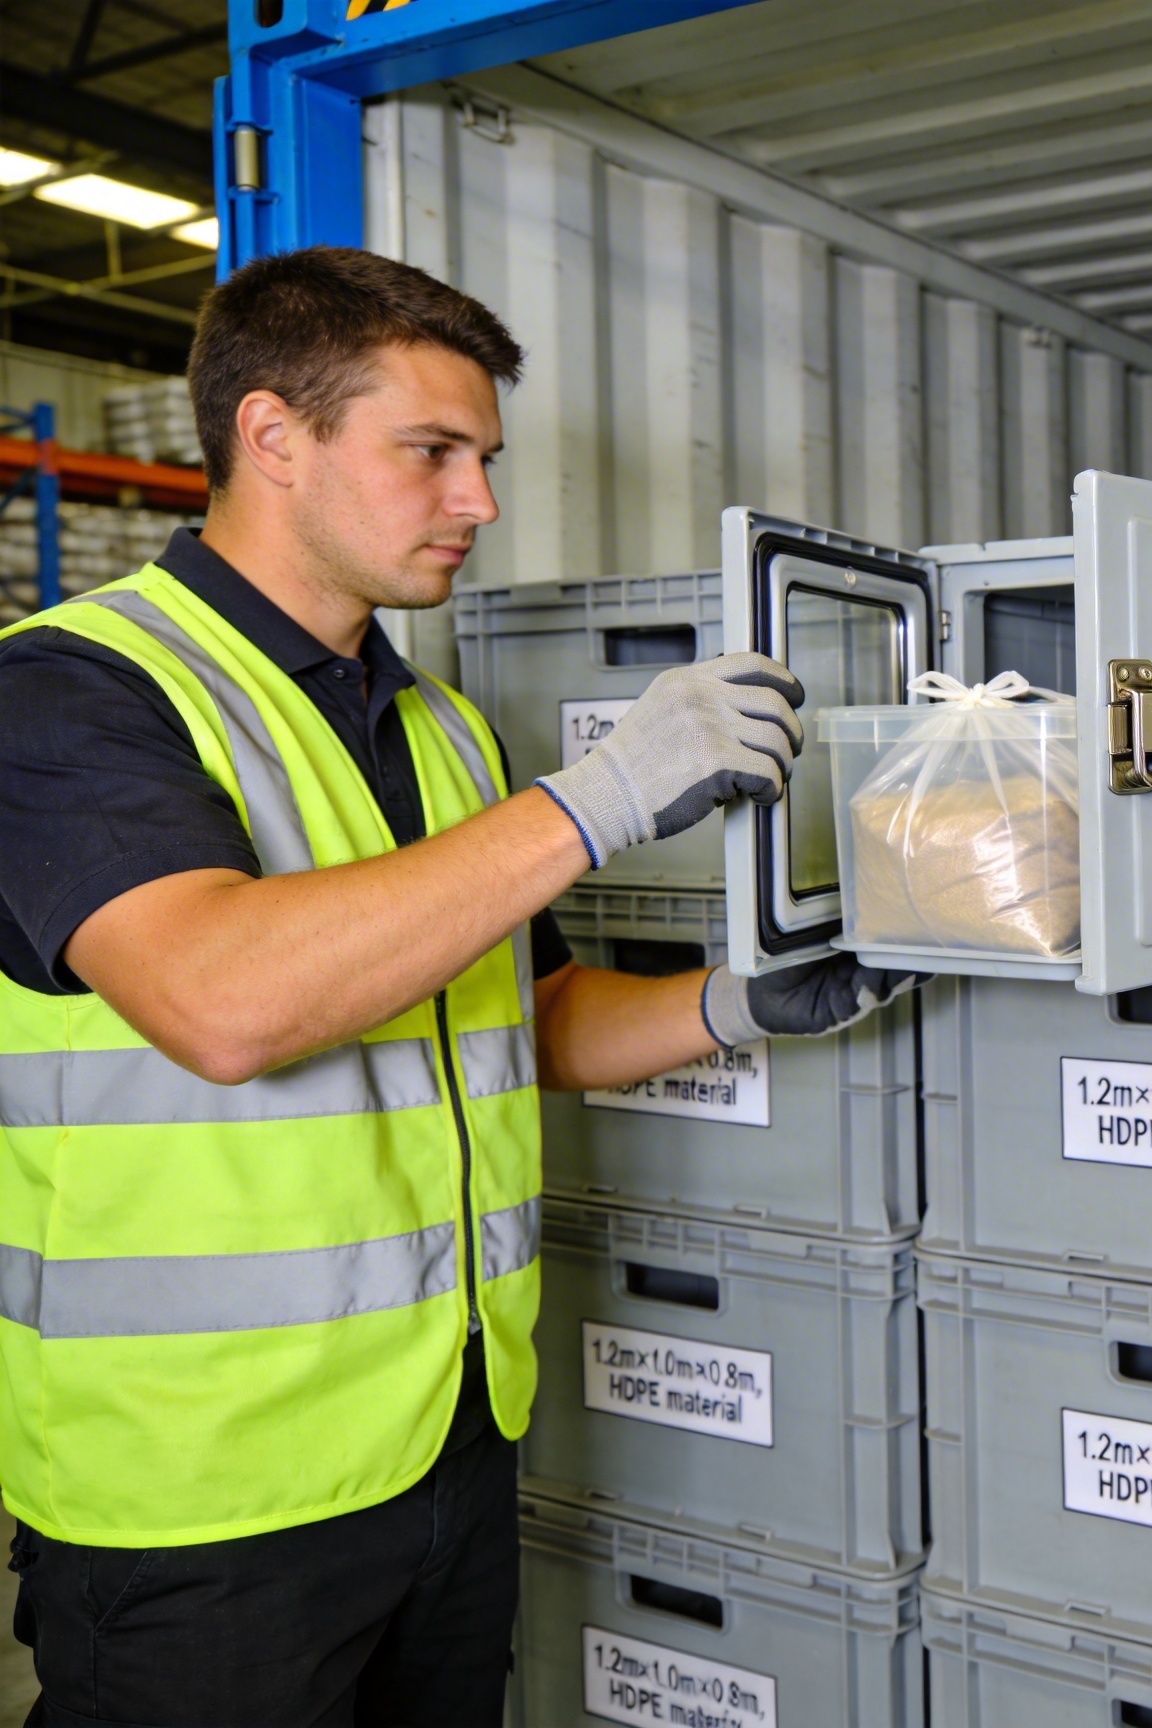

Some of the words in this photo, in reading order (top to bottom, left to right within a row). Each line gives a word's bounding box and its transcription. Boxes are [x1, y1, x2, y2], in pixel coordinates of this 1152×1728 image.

[664, 1074, 737, 1105] material
[609, 1373, 660, 1408] HDPE
[666, 1386, 742, 1424] material
[609, 1678, 663, 1720] HDPE
